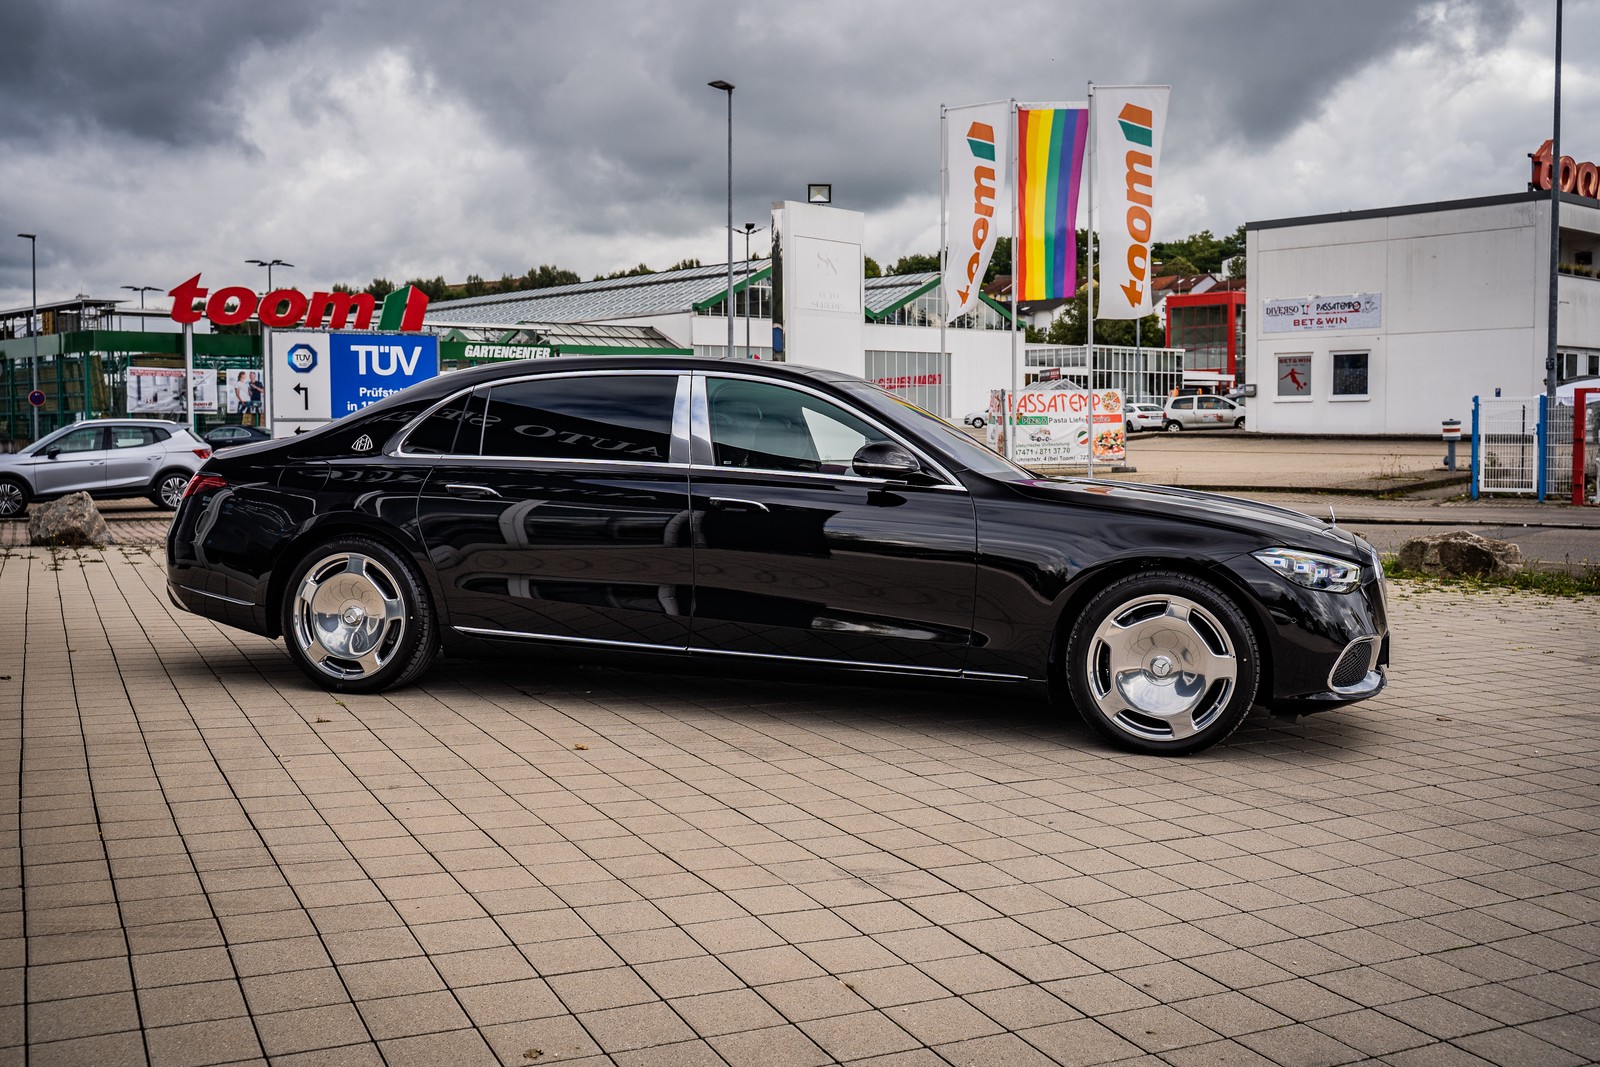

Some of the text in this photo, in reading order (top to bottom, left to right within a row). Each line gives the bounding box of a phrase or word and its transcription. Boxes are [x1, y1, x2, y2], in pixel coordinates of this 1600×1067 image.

[1531, 139, 1600, 199] too
[1120, 149, 1153, 308] toom
[957, 165, 996, 308] toom
[168, 272, 376, 330] toom
[1293, 318, 1315, 327] BET
[1325, 316, 1348, 325] WIN
[295, 353, 311, 362] TÜV
[464, 345, 551, 359] GARTENCENTER
[350, 344, 422, 376] TÜV
[359, 387, 406, 398] Prüfst
[347, 401, 358, 412] in
[1049, 416, 1068, 424] Pasta
